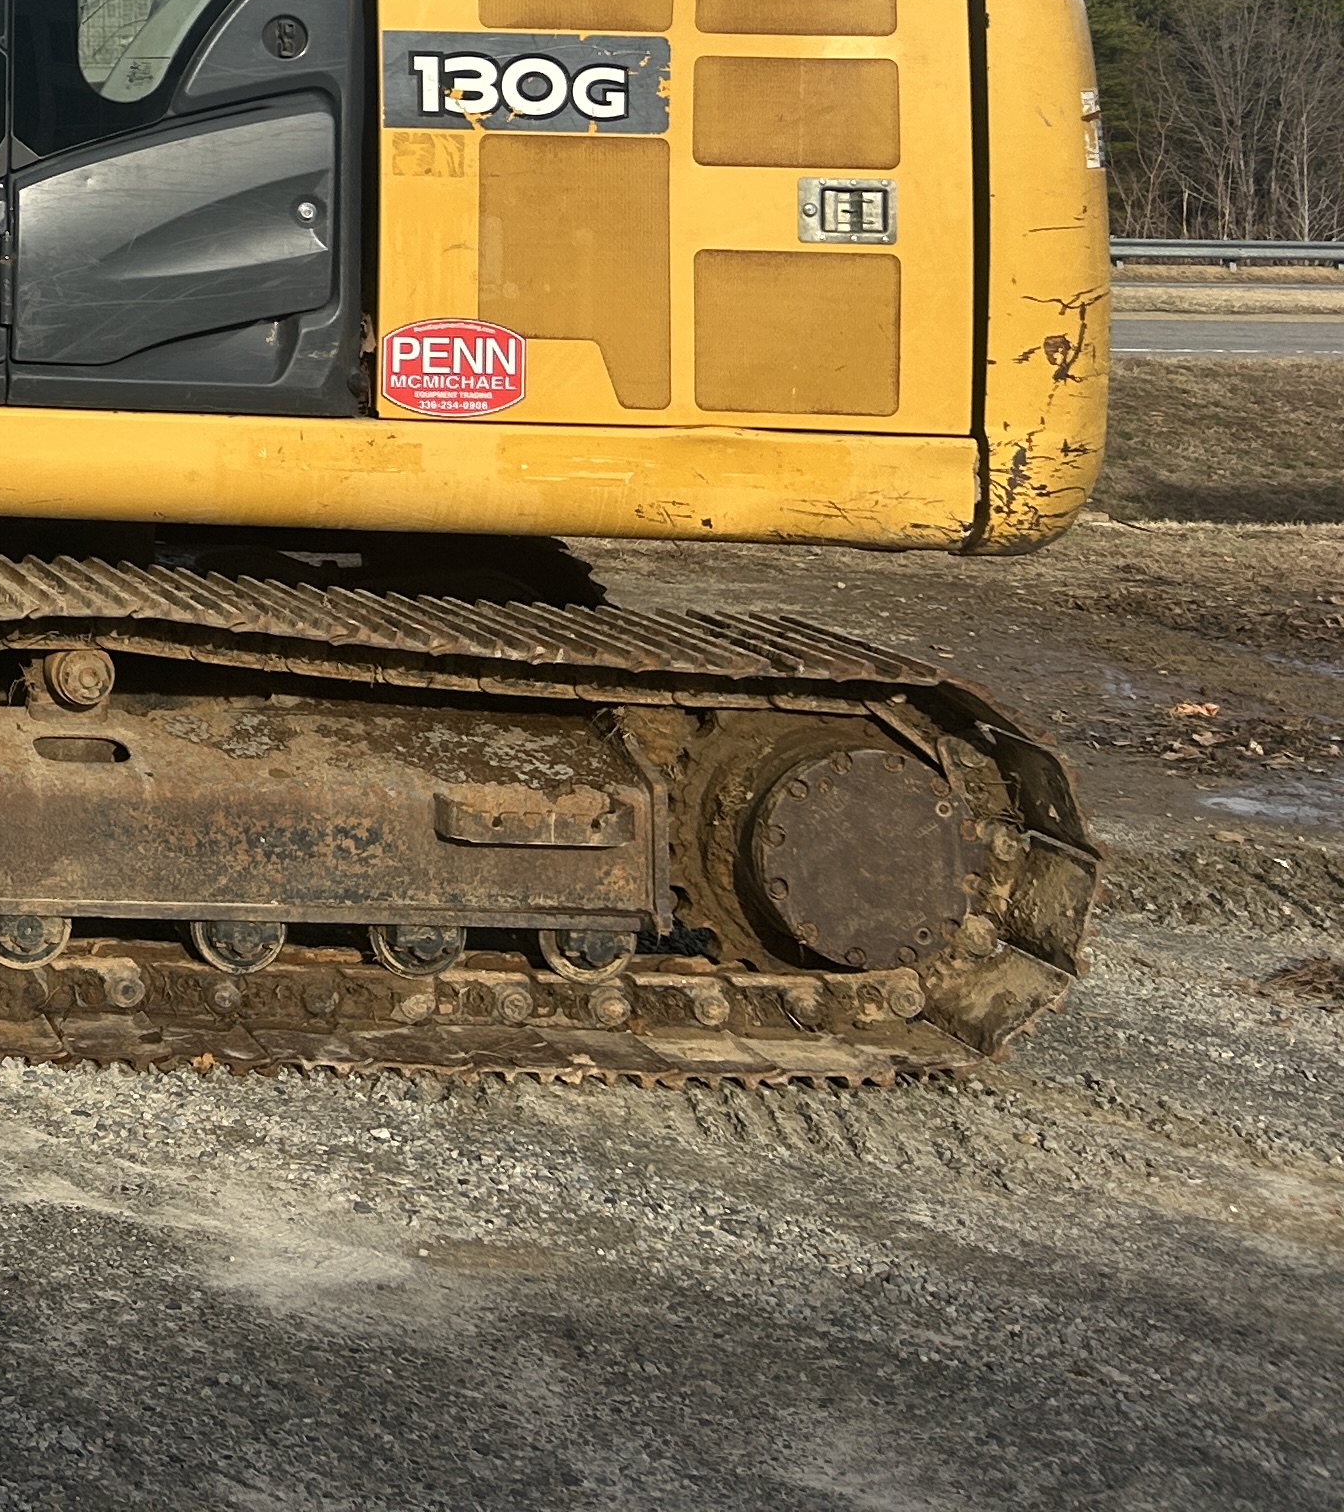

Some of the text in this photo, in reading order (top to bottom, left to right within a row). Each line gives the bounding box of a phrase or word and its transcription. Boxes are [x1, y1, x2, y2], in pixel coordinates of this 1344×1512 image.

[410, 52, 630, 120] 130G
[391, 336, 516, 375] PENN
[390, 374, 517, 390] MCMICHAEL
